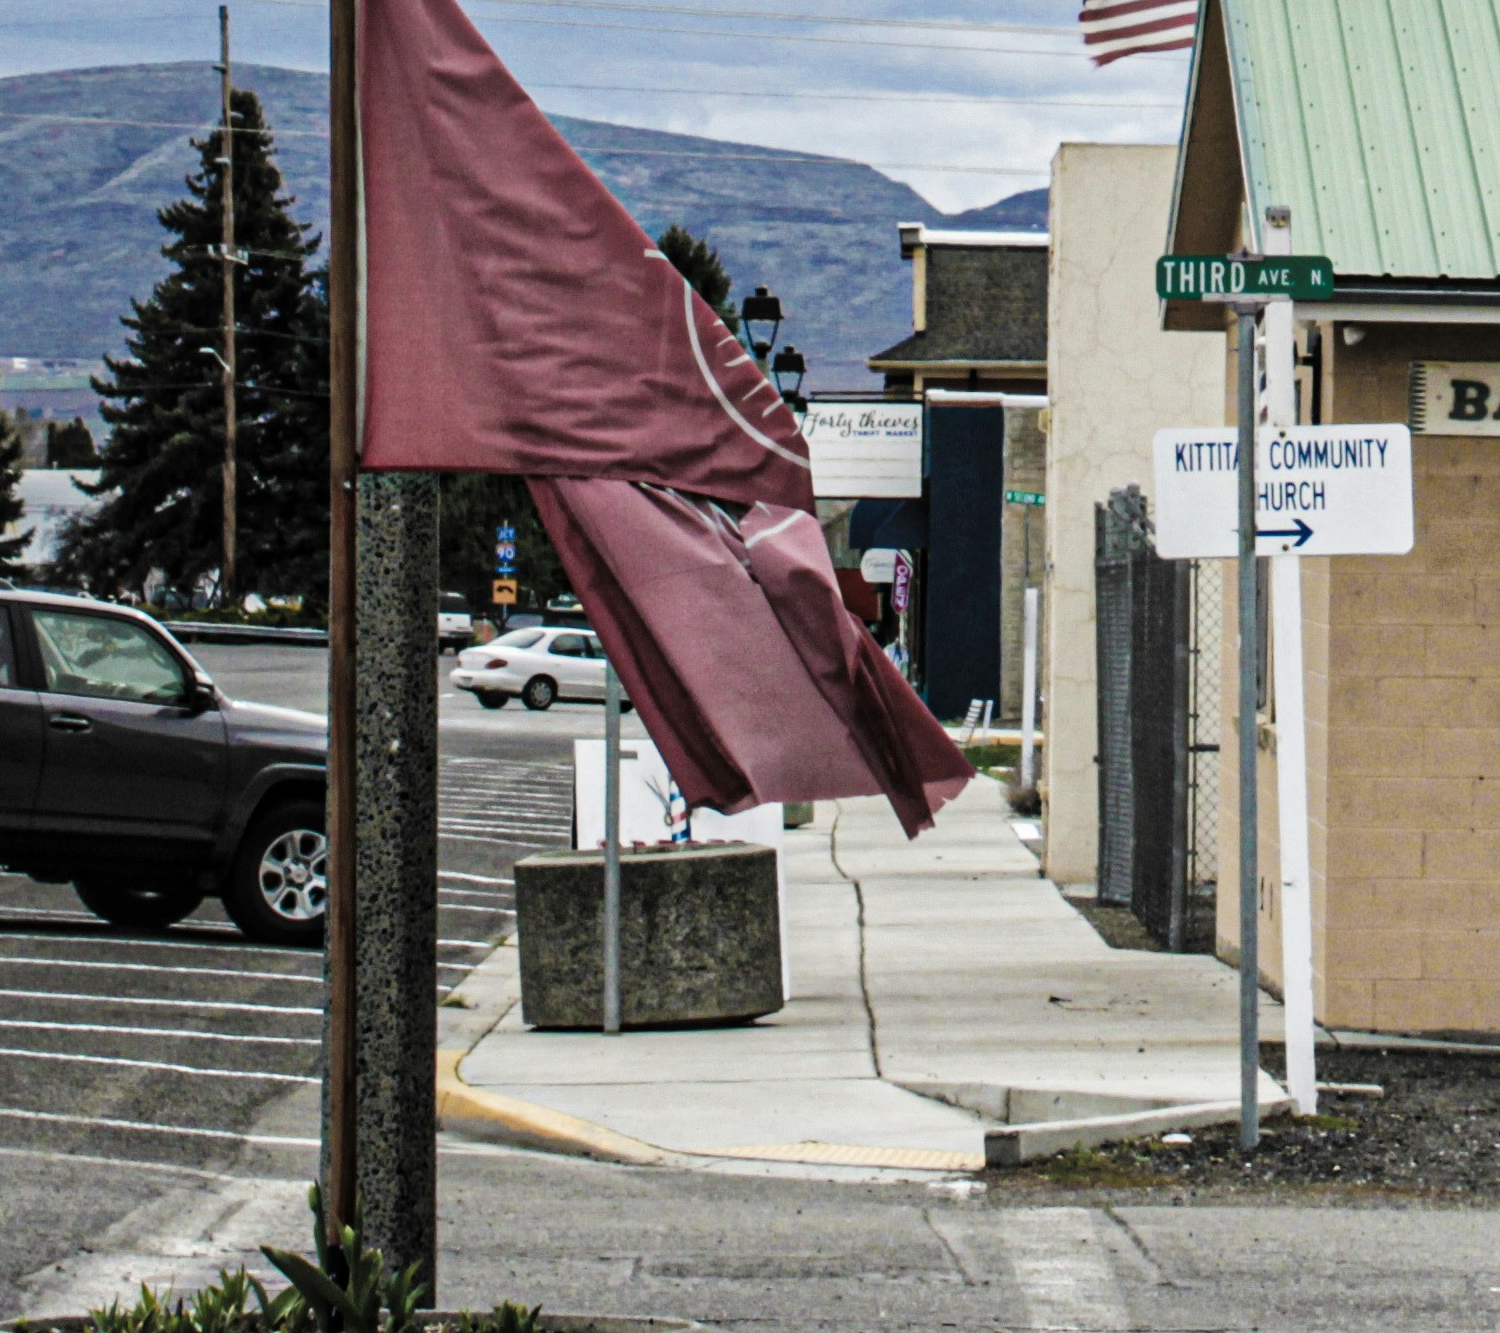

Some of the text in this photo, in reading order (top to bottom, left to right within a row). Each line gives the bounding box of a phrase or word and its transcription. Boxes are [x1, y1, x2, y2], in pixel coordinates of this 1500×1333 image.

[1163, 261, 1246, 294] THIRD
[859, 410, 919, 430] thieves
[1175, 438, 1389, 472] KITTIT COMMUNITY
[1257, 481, 1327, 511] HURCH
[496, 546, 515, 560] 90
